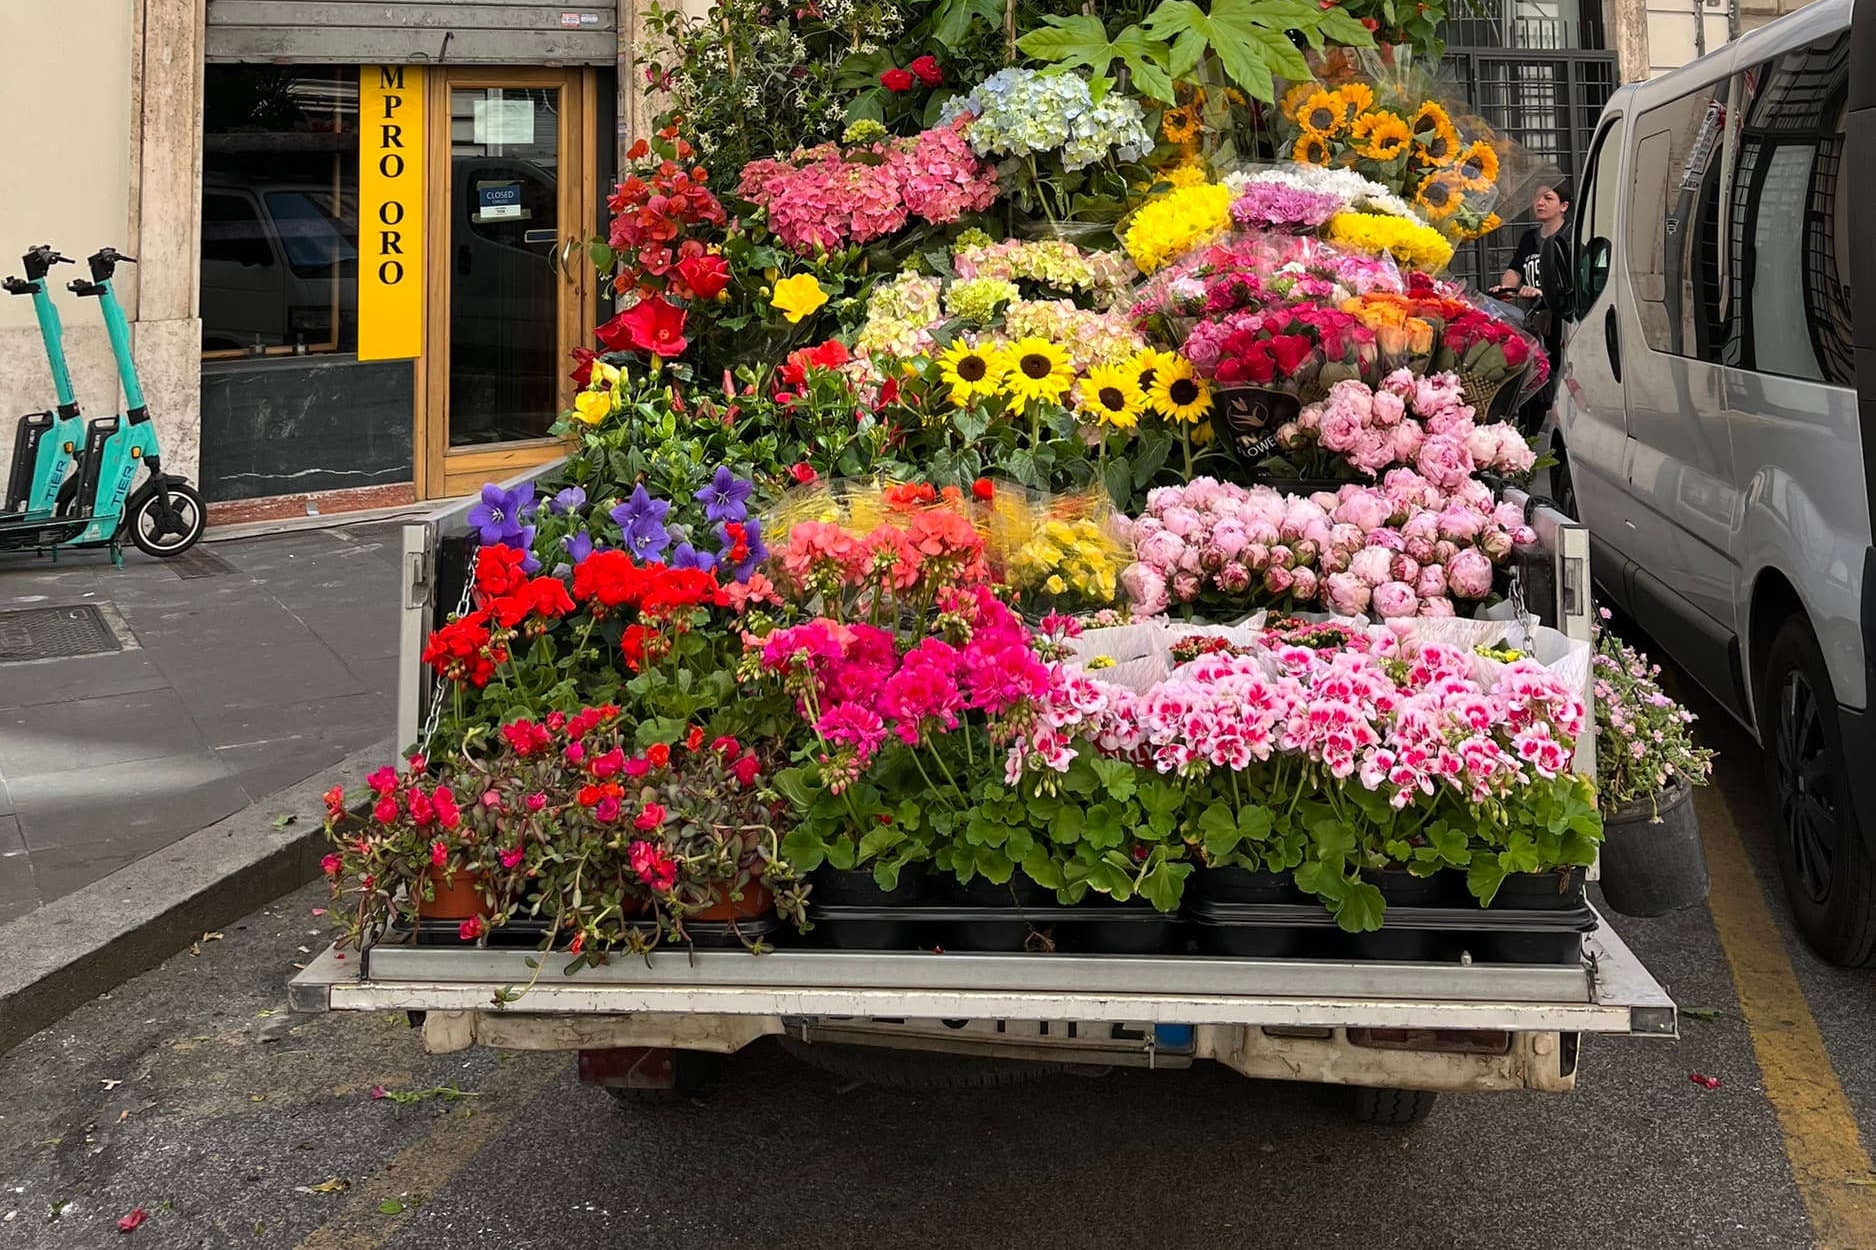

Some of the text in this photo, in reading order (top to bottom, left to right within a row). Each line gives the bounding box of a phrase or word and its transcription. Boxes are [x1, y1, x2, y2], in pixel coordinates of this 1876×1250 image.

[486, 190, 514, 200] CLOSED
[378, 201, 404, 285] ORO
[28, 430, 36, 449] TIER
[93, 434, 101, 454] TIER
[45, 459, 67, 502] TIER
[110, 464, 135, 508] TIER
